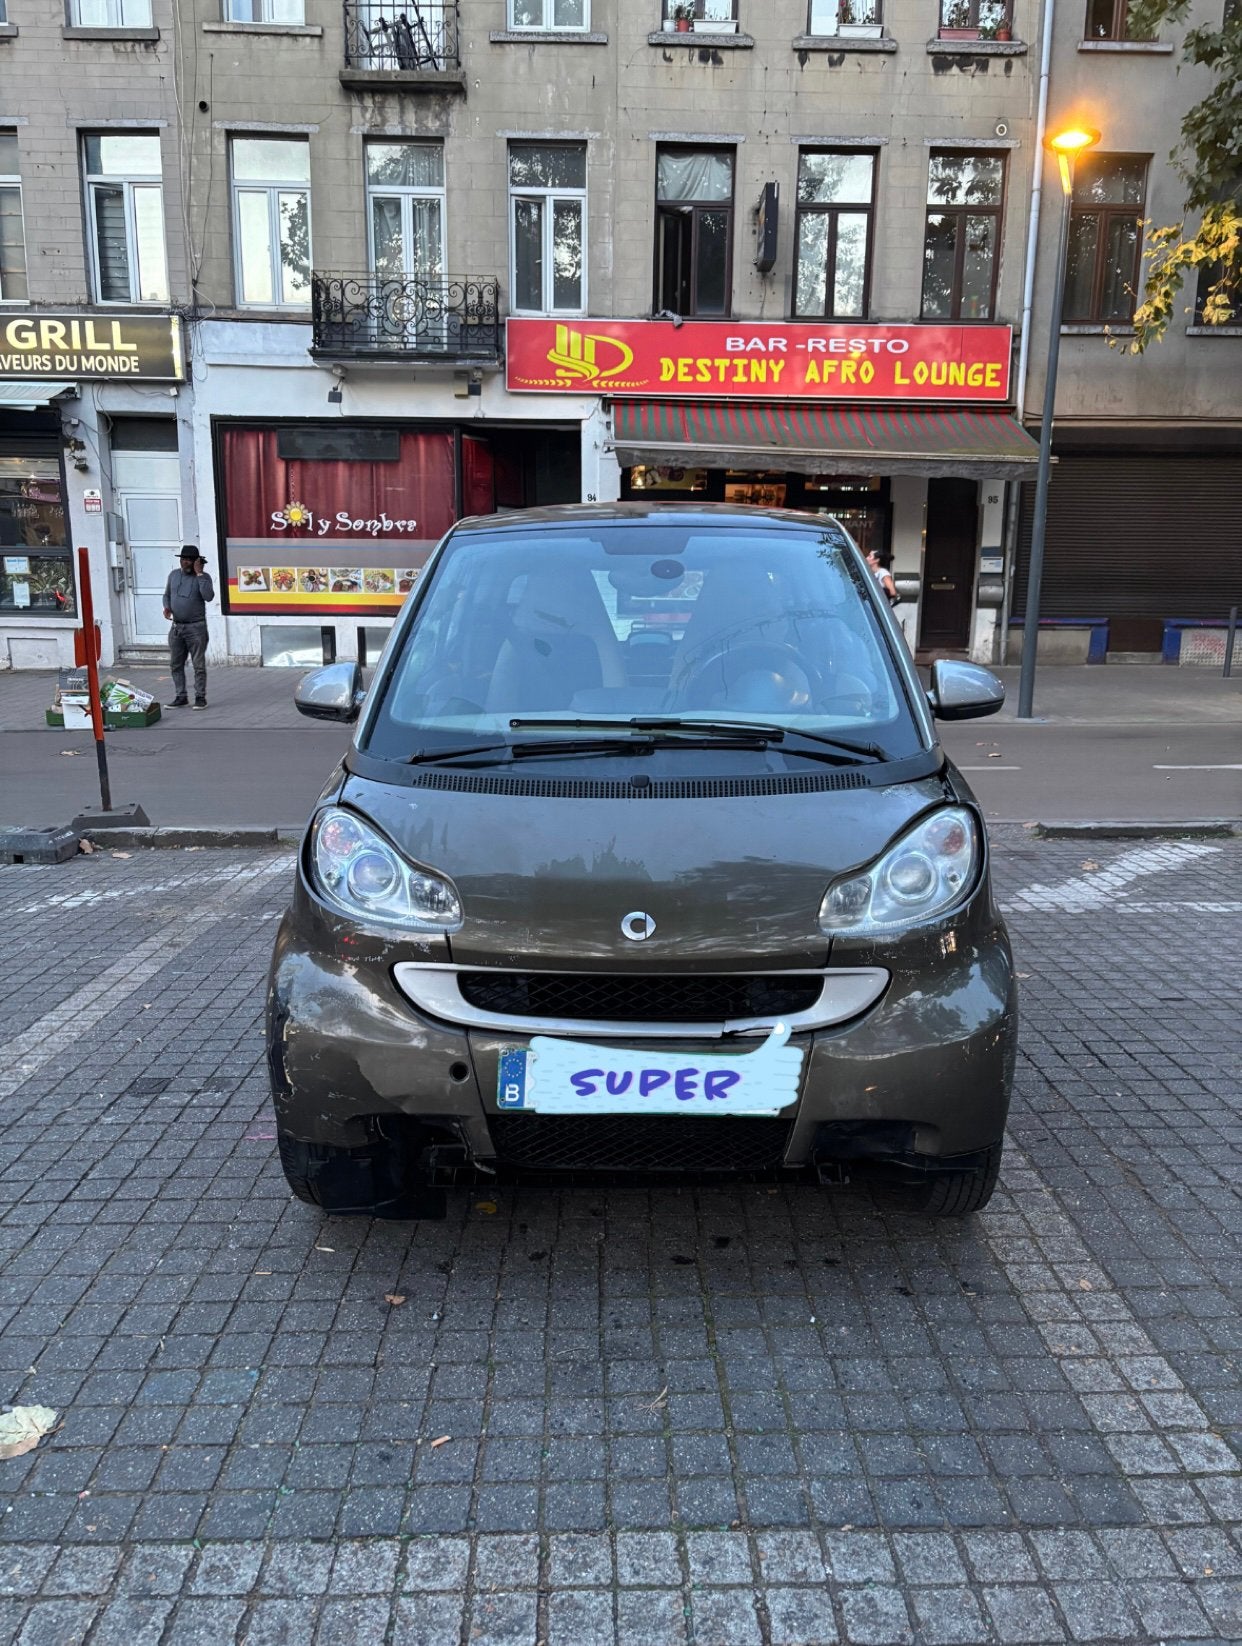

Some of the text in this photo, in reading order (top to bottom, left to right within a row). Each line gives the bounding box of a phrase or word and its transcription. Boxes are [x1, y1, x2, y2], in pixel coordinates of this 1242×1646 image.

[5, 319, 138, 350] GRILL
[726, 337, 788, 352] BAR
[0, 354, 140, 372] VEURS DU MONDE
[659, 357, 1002, 387] DESTINY AFRO LOUNGE
[587, 493, 597, 502] 94
[317, 518, 331, 535] y
[335, 511, 417, 536] Sombra
[505, 1083, 519, 1101] B
